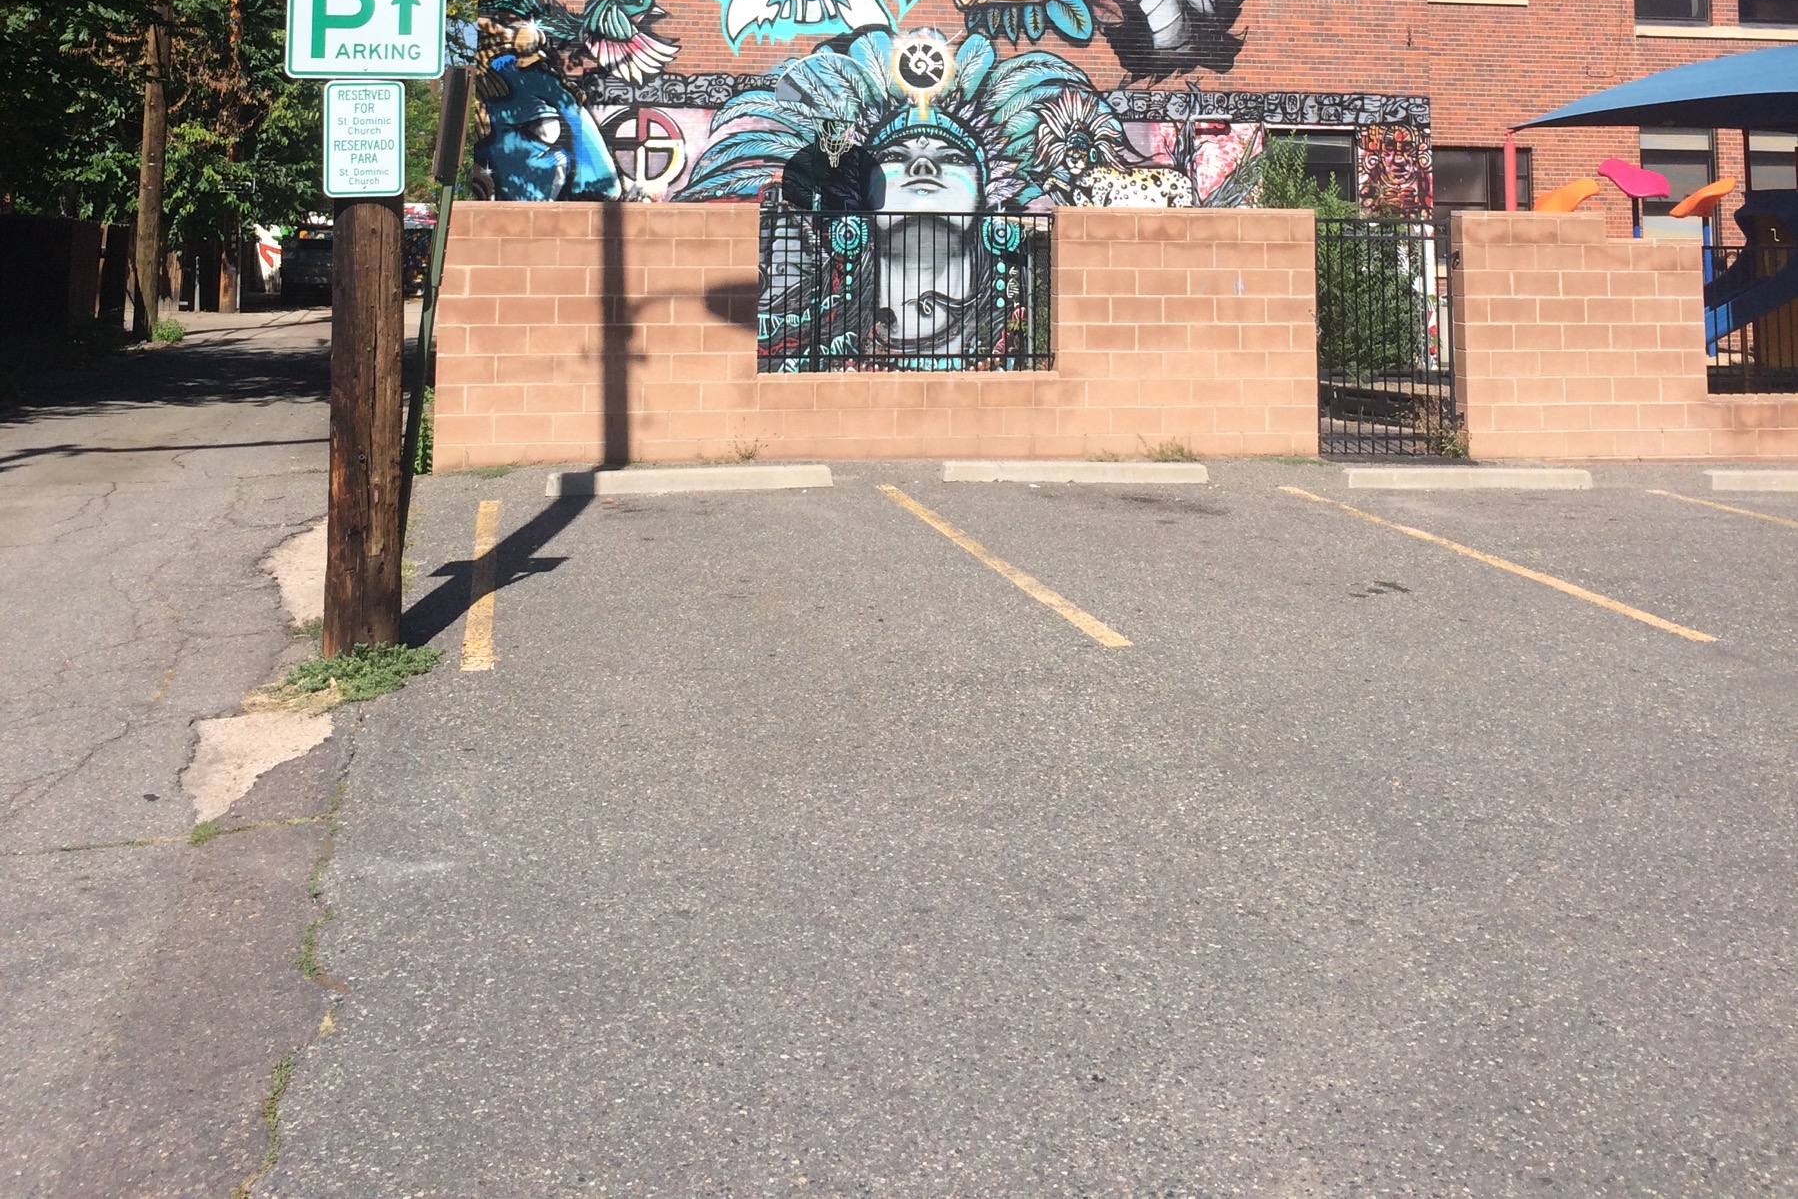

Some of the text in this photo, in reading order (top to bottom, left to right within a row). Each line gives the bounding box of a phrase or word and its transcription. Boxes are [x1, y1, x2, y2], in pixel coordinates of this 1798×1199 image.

[338, 89, 391, 101] RESERVED
[354, 102, 375, 114] FOR
[352, 116, 392, 126] Dominic
[347, 126, 382, 135] Church
[333, 139, 395, 152] RESERVADO
[350, 153, 379, 165] PARA
[353, 167, 390, 177] Dominic
[348, 177, 380, 186] Church
